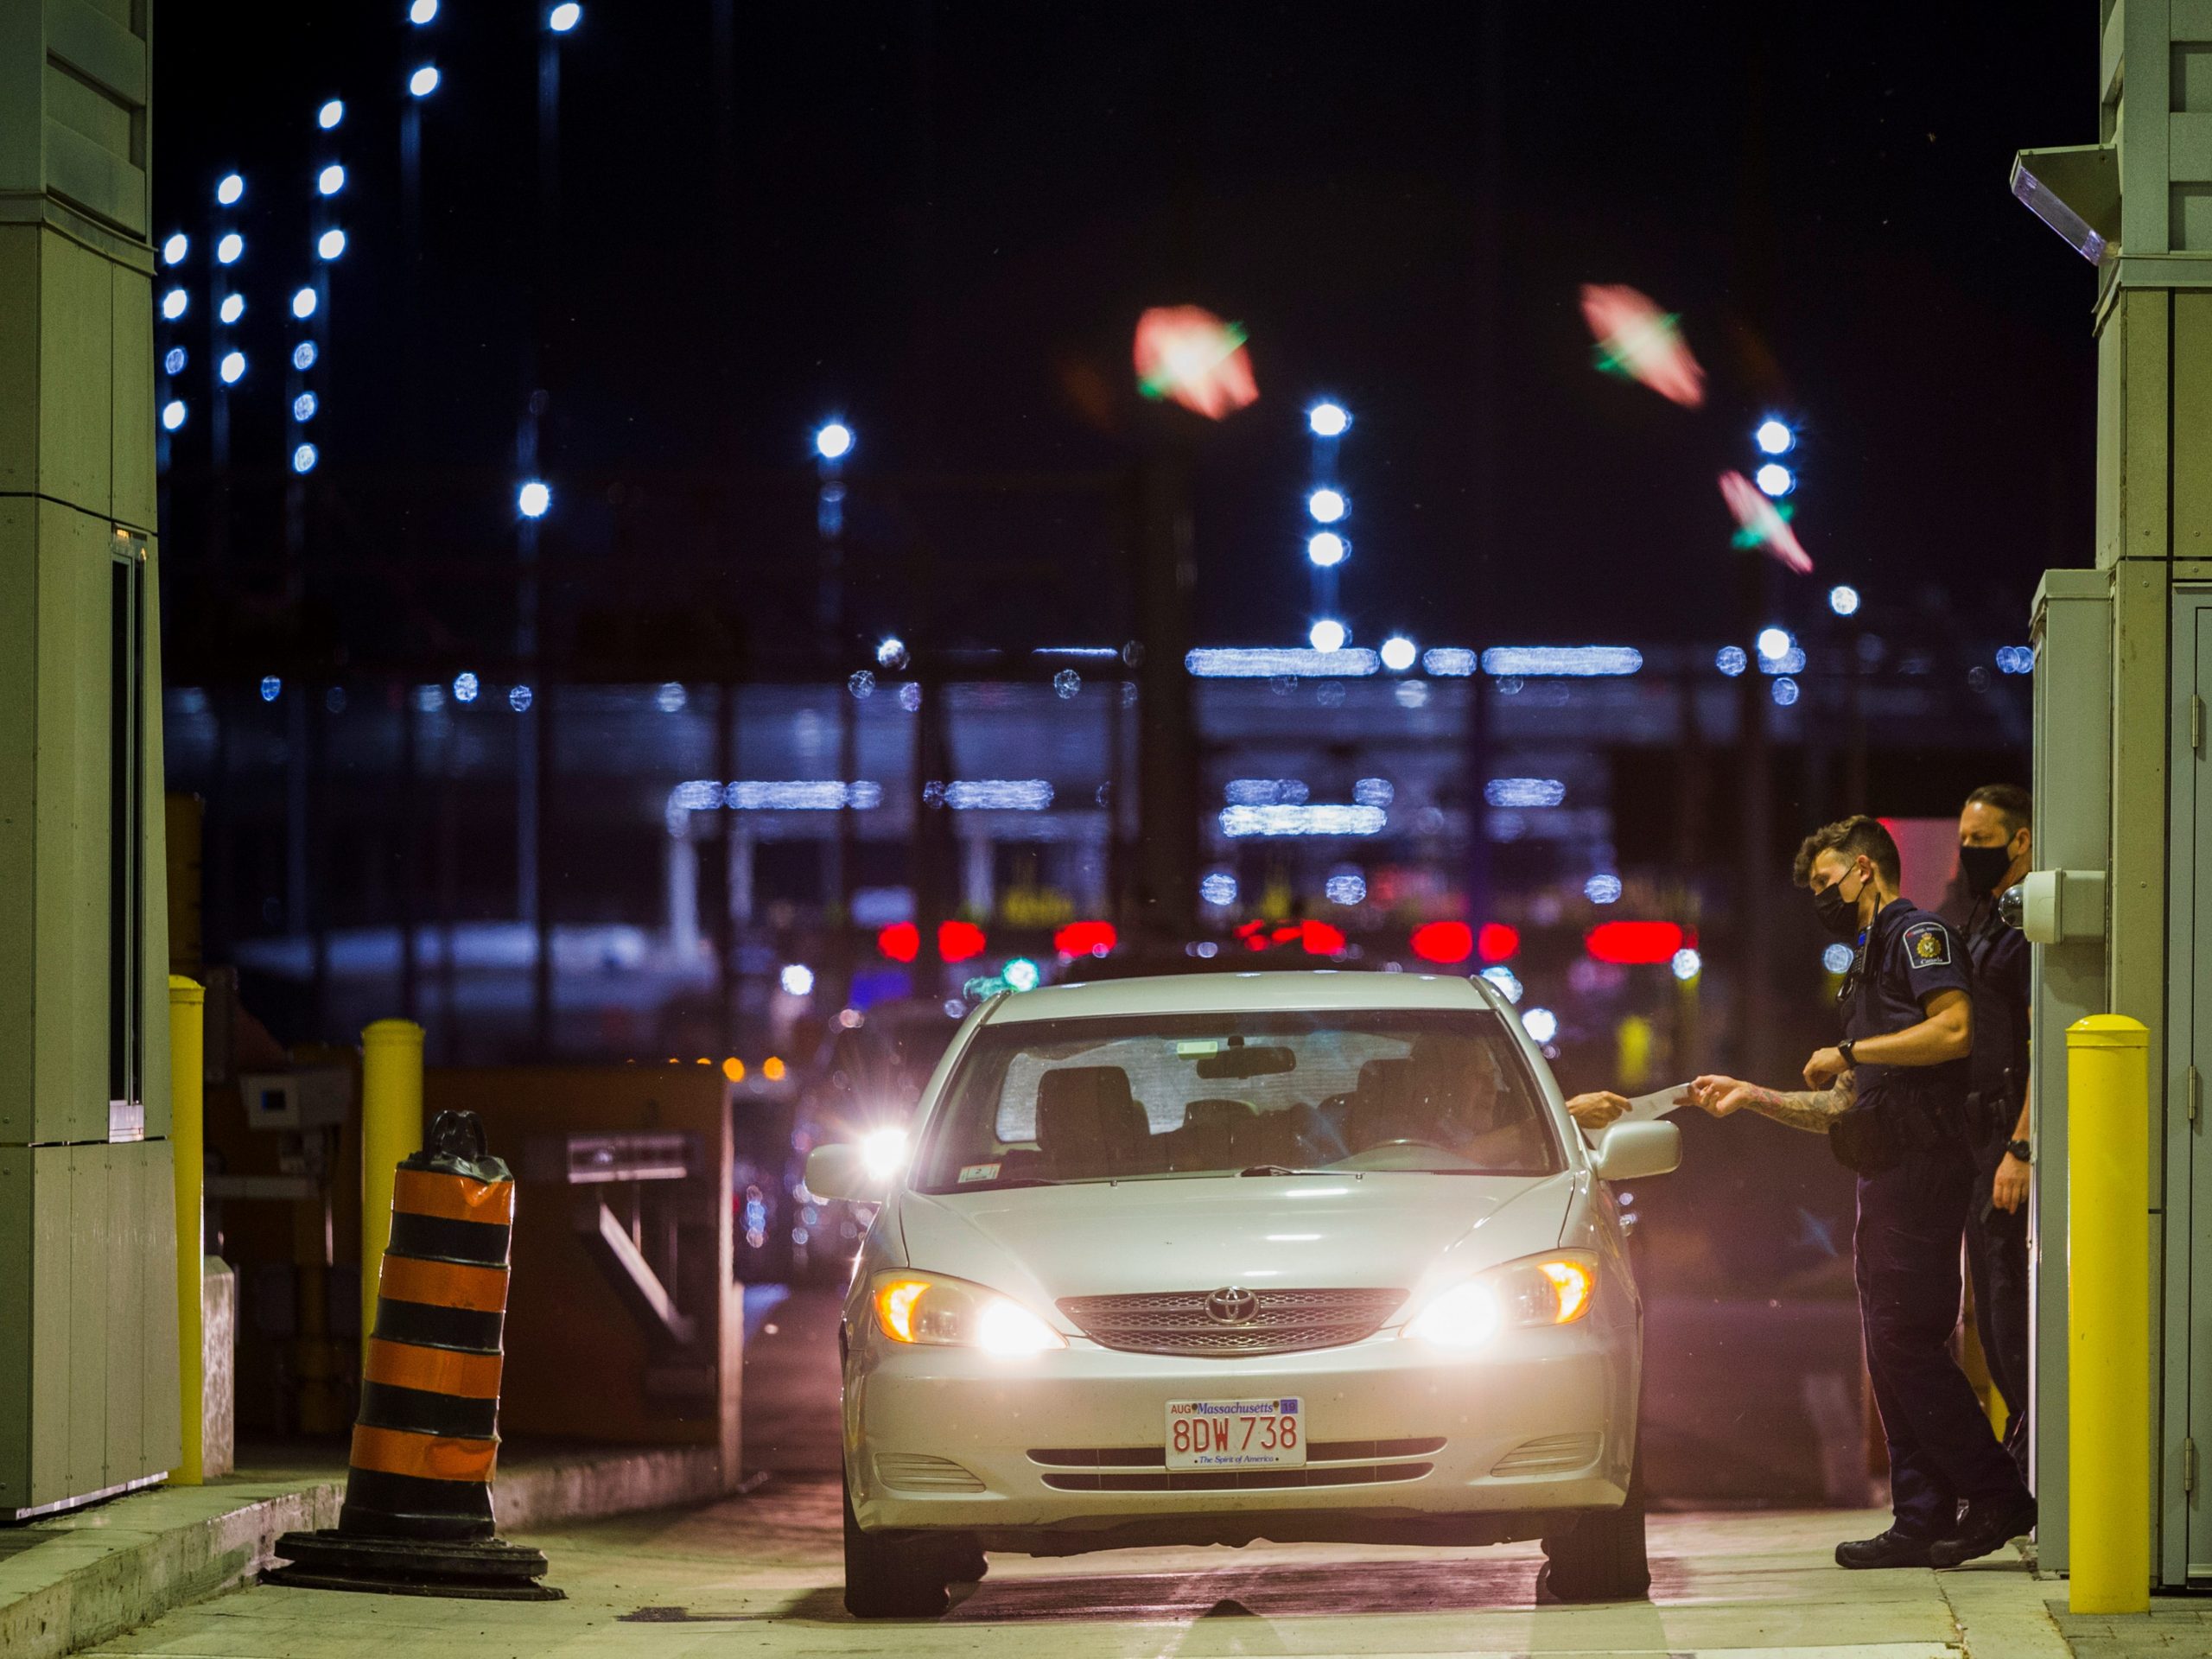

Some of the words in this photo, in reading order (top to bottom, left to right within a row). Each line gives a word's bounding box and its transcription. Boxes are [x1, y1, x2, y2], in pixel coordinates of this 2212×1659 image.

[1171, 1404, 1192, 1414] AUG
[1198, 1402, 1273, 1414] Massachusetts
[1283, 1402, 1296, 1412] 19
[1173, 1418, 1230, 1452] 8DW
[1240, 1416, 1297, 1450] 738
[1215, 1455, 1234, 1465] Spirit
[1235, 1455, 1243, 1464] of
[1244, 1454, 1274, 1463] America
